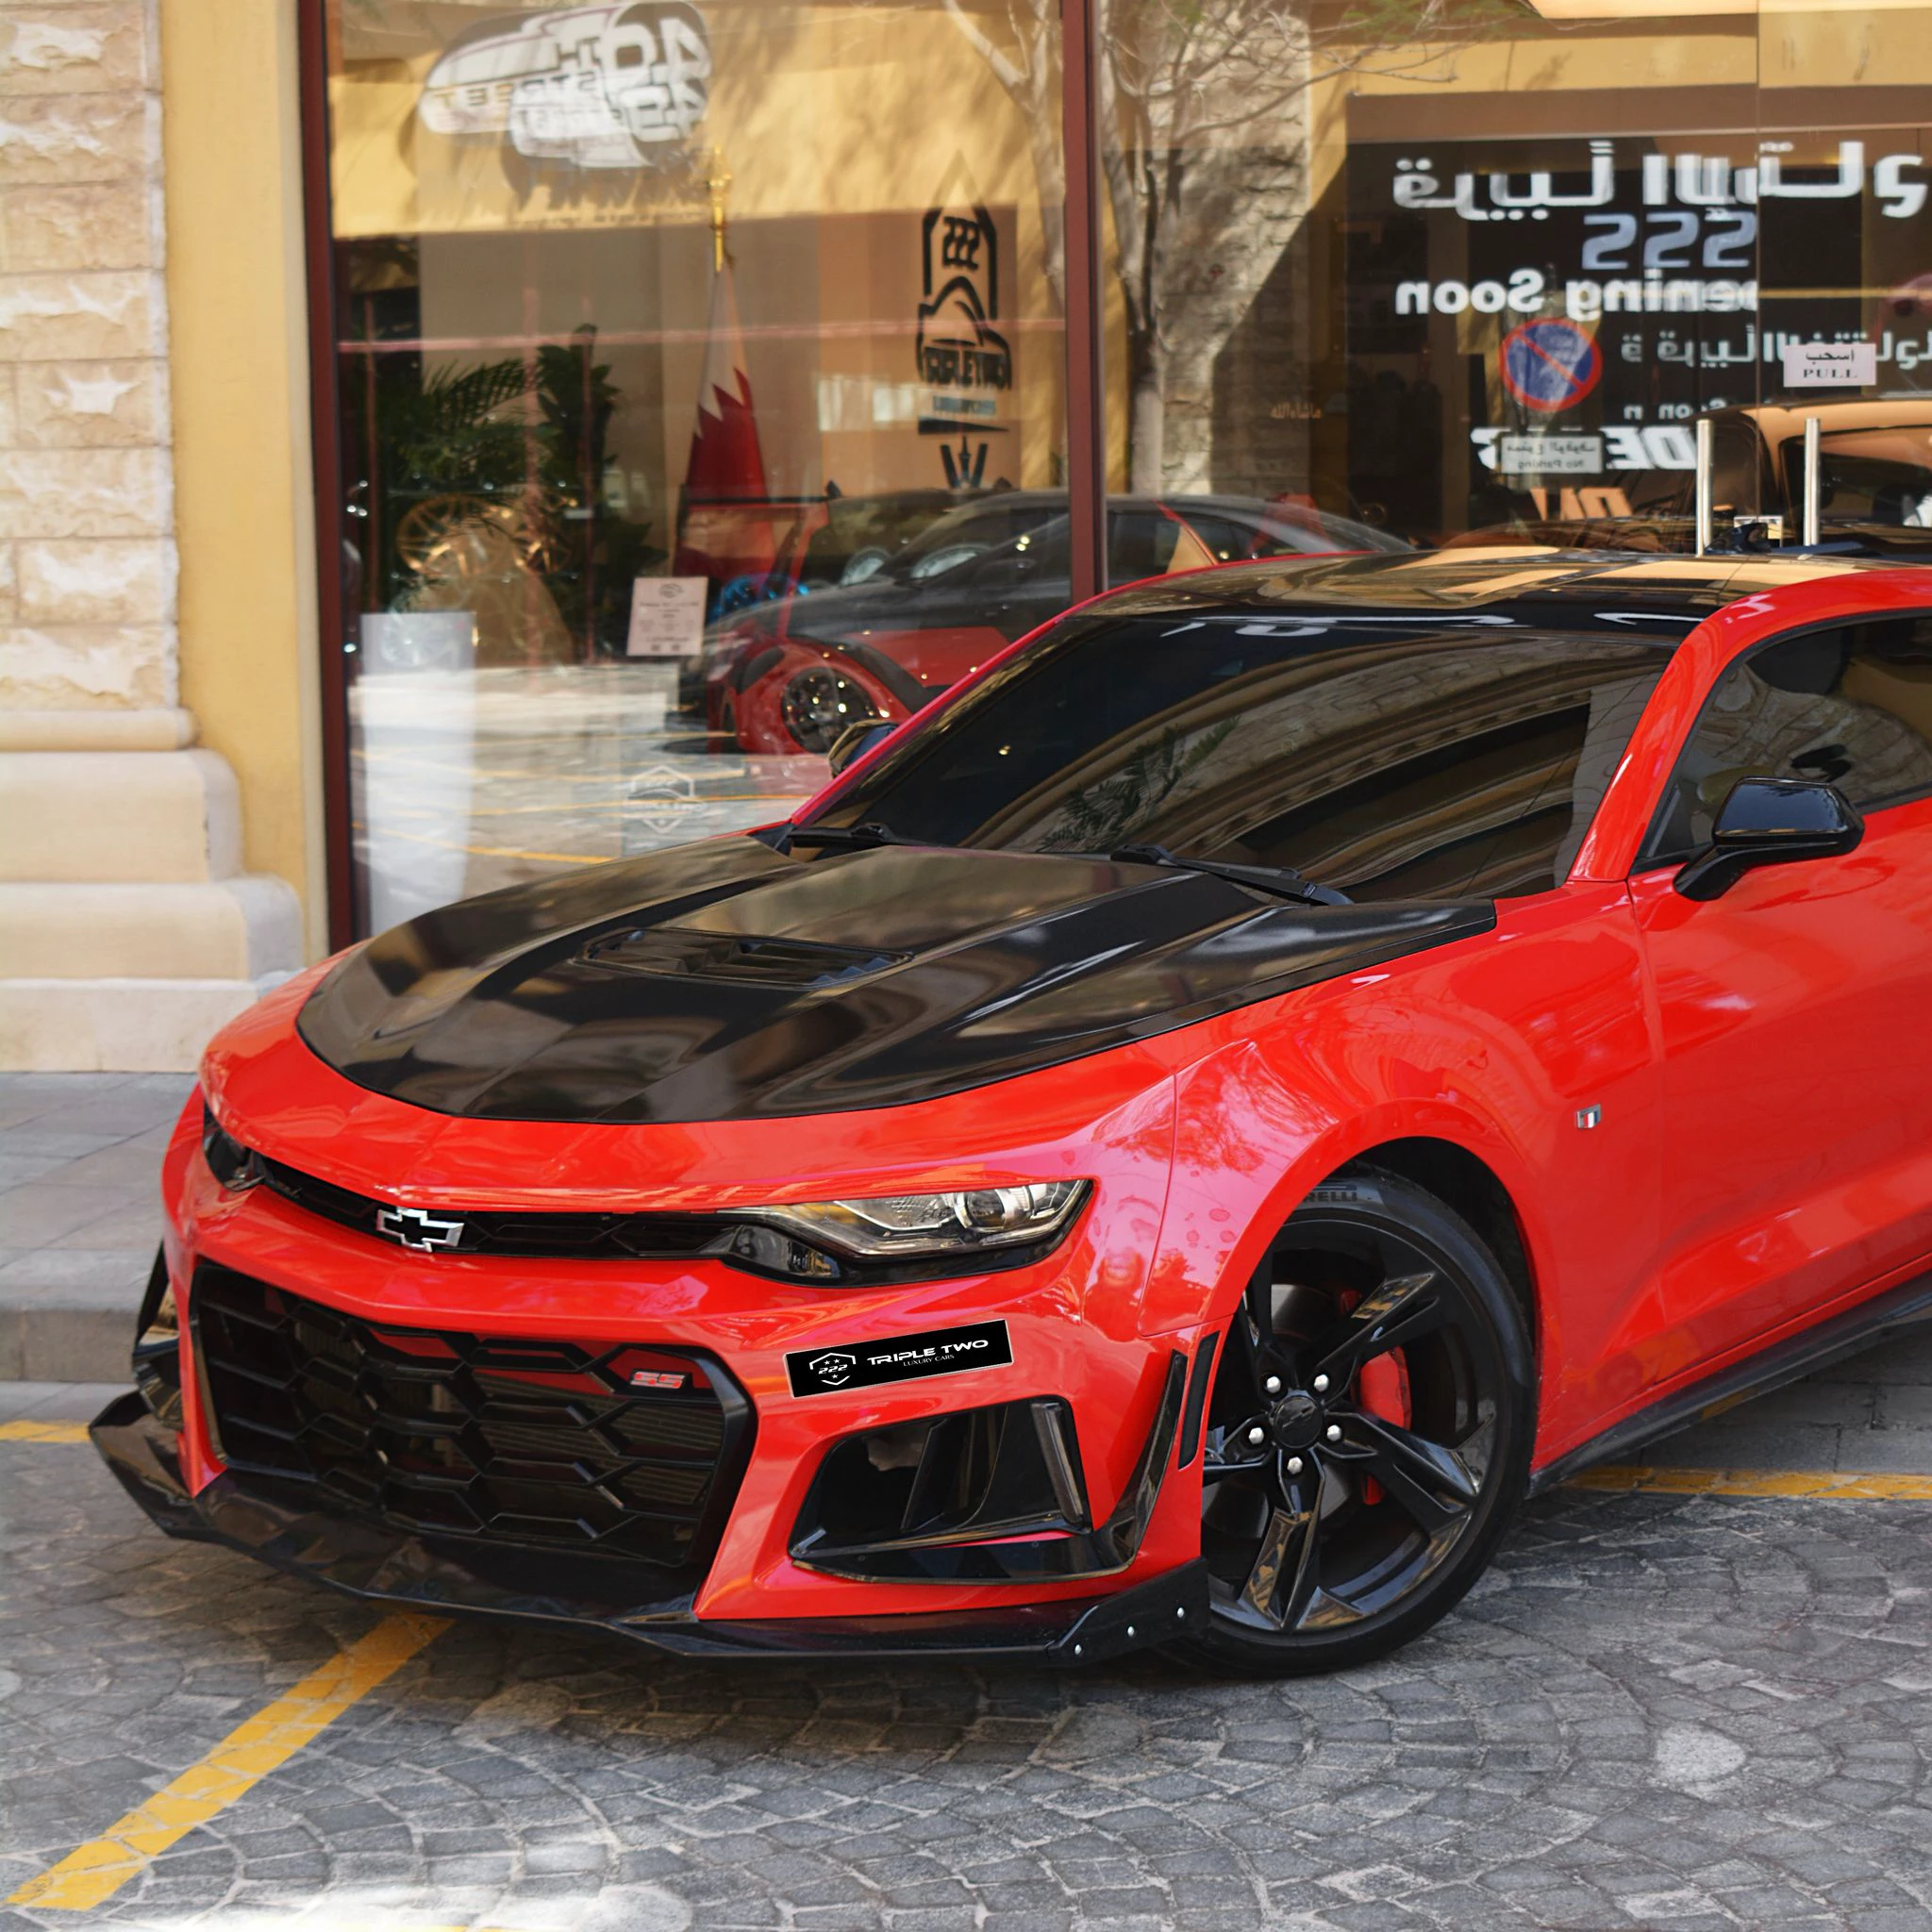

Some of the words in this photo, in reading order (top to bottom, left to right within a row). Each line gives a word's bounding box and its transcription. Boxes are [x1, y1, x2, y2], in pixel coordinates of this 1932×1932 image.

[1582, 211, 1757, 270] 222
[1804, 369, 1857, 378] PULL
[1306, 1191, 1357, 1203] RELLI
[867, 1347, 936, 1365] TRIPLE
[941, 1340, 989, 1354] TWO
[903, 1357, 933, 1367] LUXURY
[818, 1364, 848, 1374] 222
[630, 1371, 686, 1389] SS
